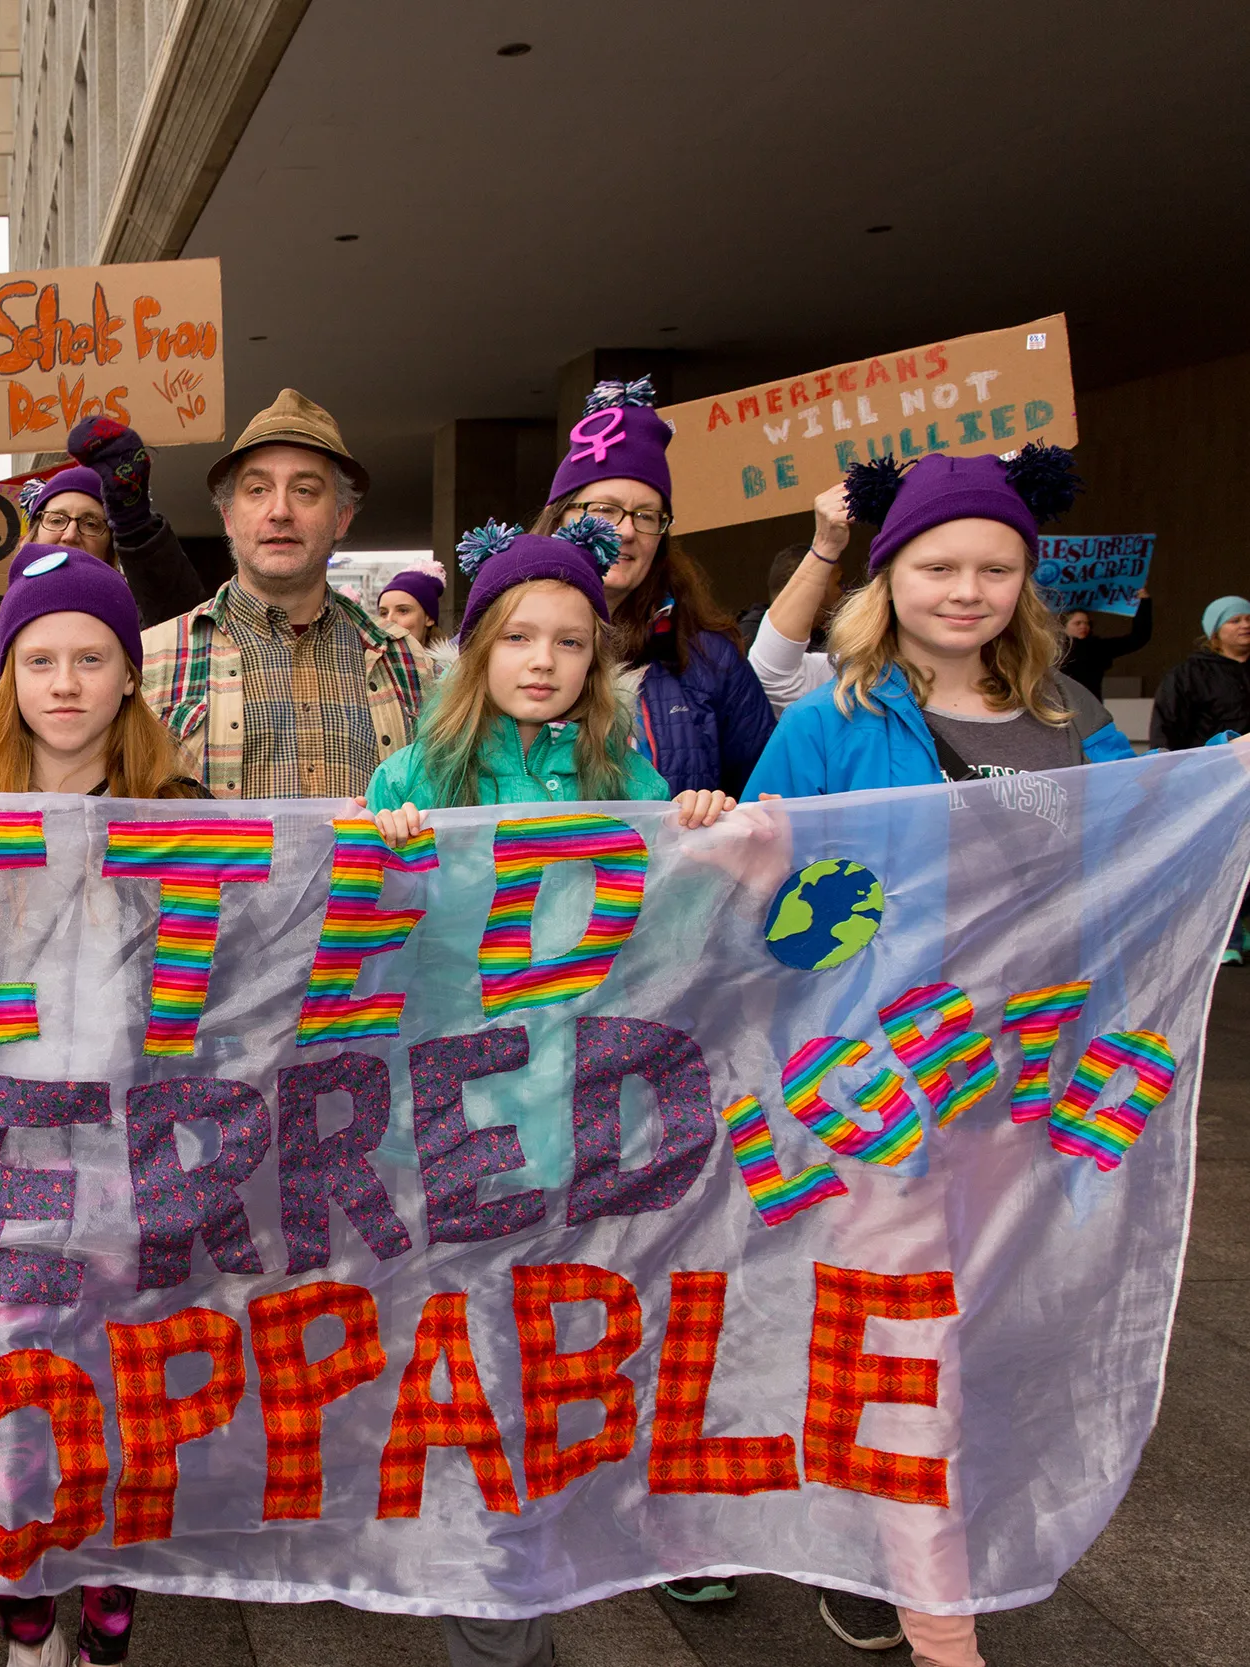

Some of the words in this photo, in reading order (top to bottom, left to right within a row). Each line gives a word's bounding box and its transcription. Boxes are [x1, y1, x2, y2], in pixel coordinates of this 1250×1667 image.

[152, 368, 204, 404] VOTE
[176, 394, 206, 428] NO
[706, 344, 949, 433] AMERICANS
[762, 395, 880, 445] WILL
[899, 369, 1002, 418] NOT
[741, 454, 800, 499] BE
[834, 399, 1055, 473] BULLIED
[720, 980, 1177, 1228] LGBTQ
